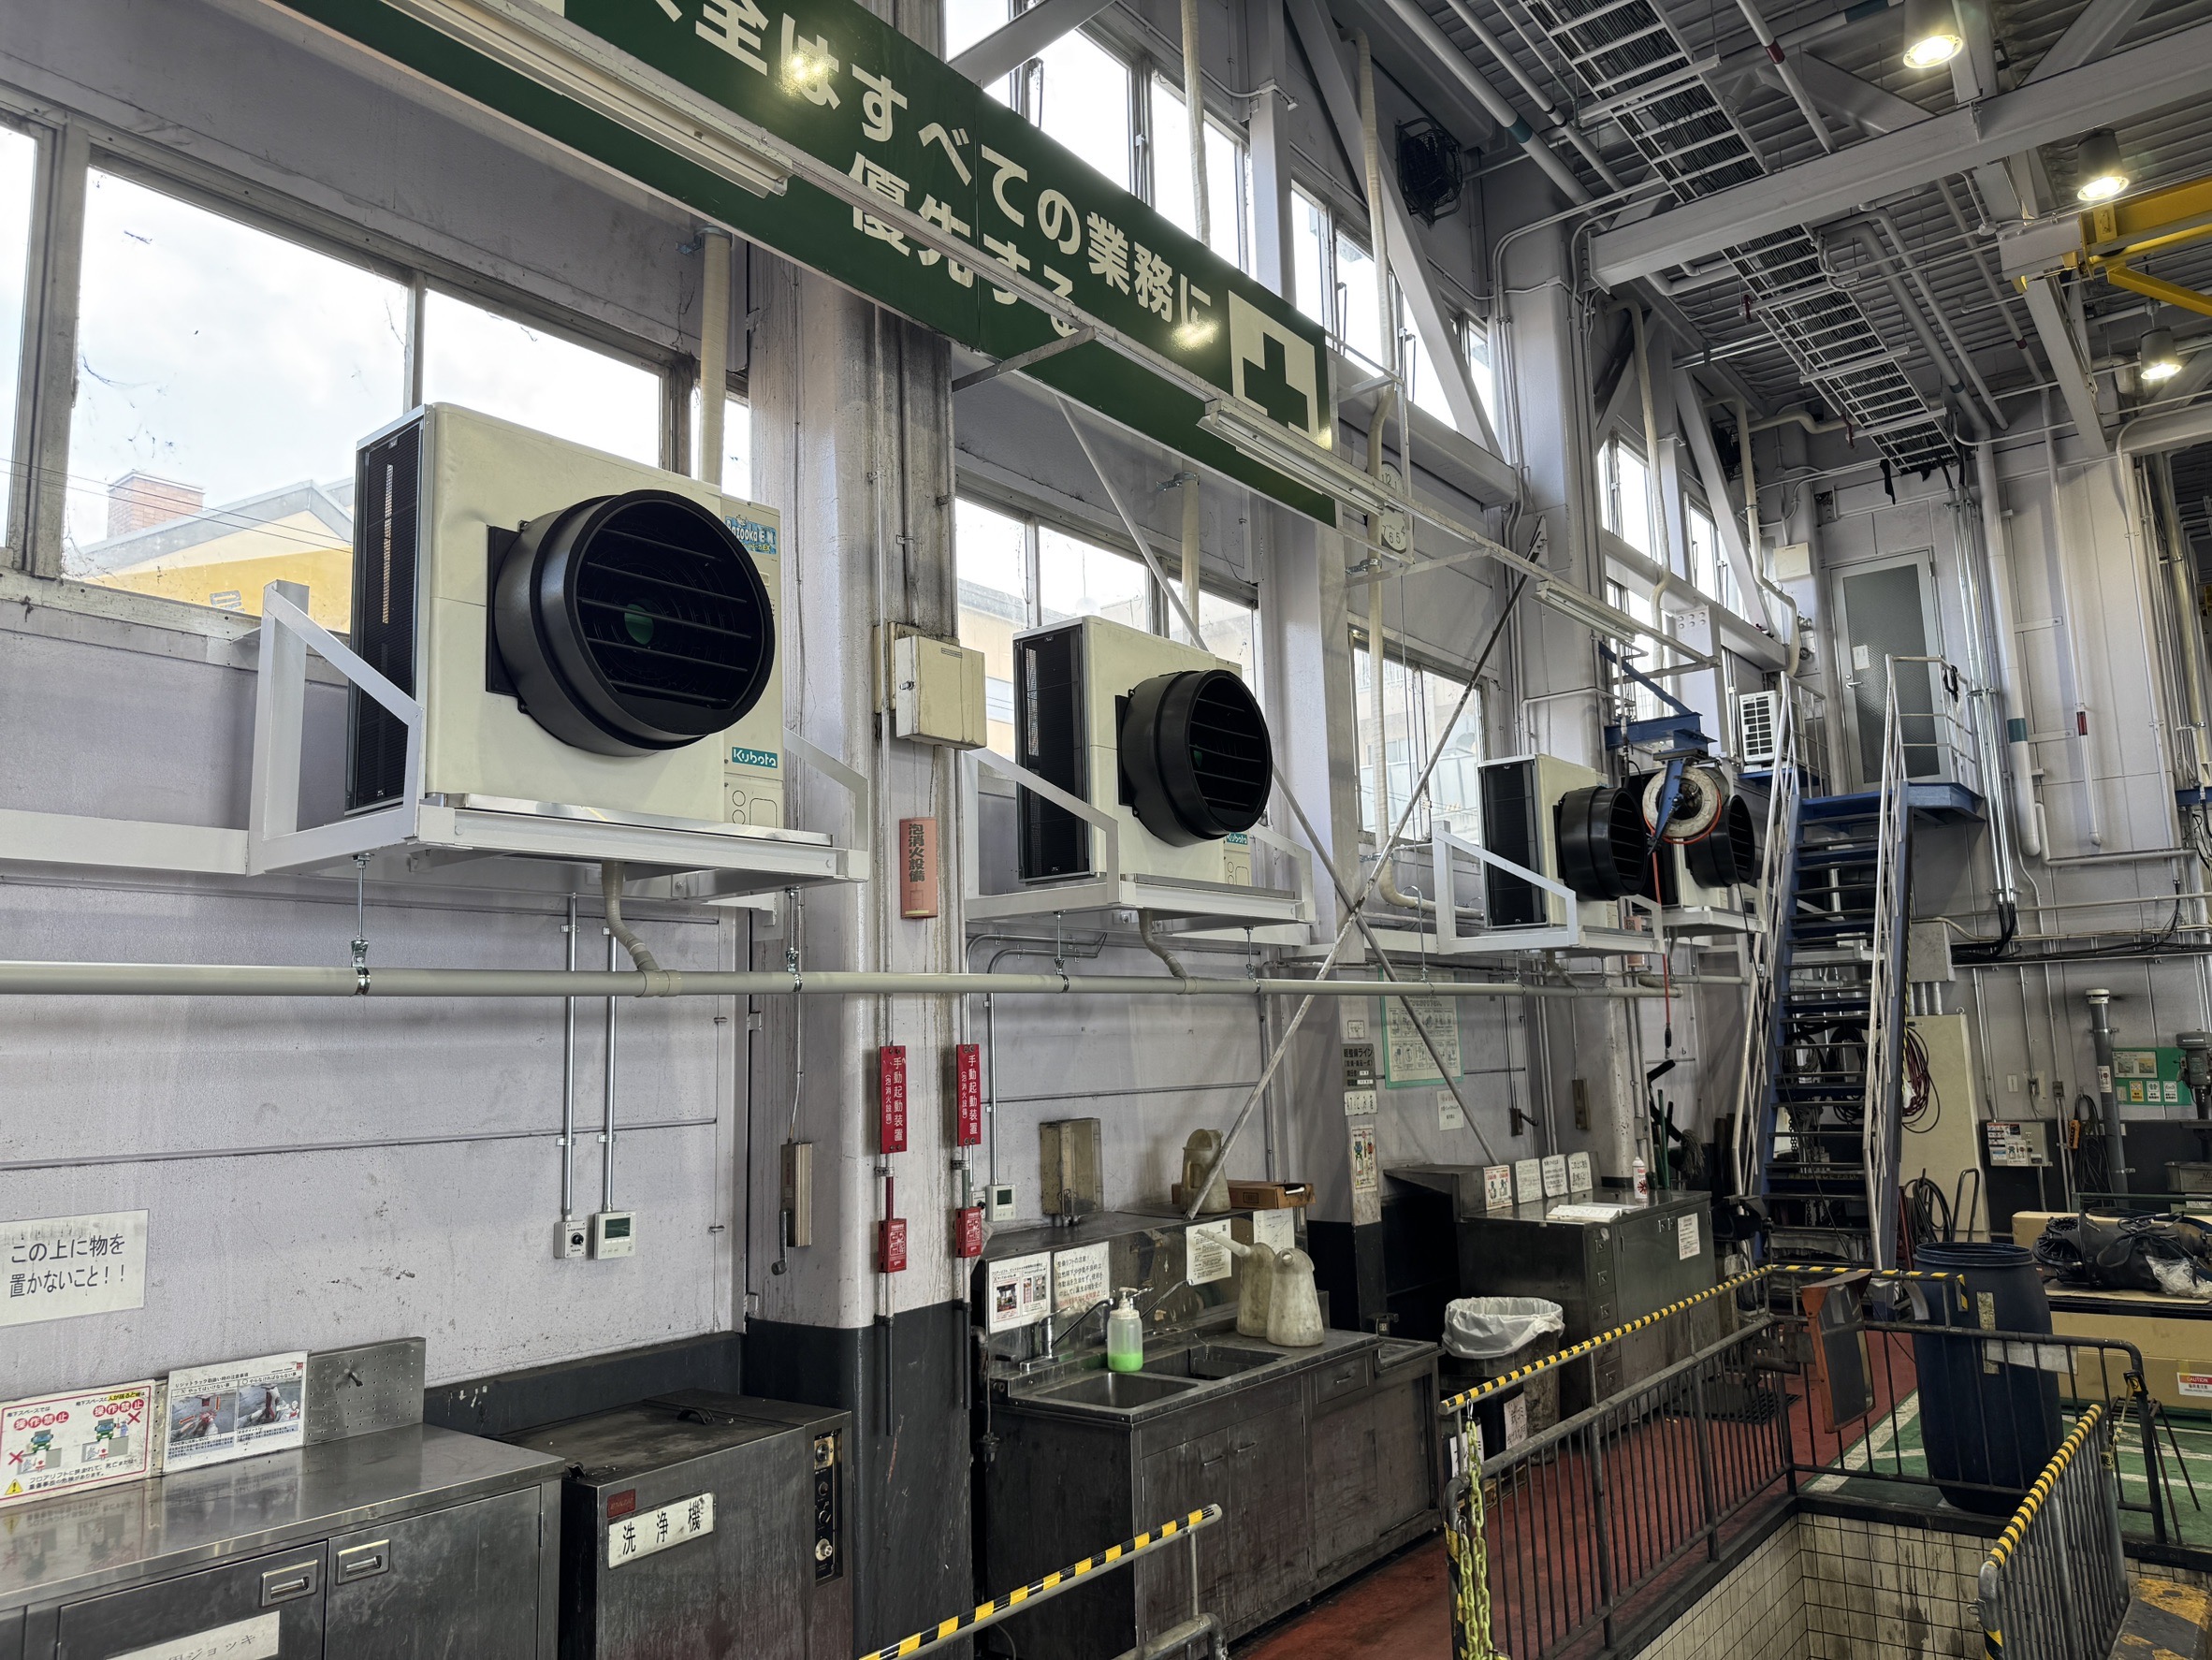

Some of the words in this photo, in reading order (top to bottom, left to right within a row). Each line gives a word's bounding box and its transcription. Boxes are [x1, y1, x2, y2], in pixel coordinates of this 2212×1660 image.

[657, 0, 1214, 343] 全はすべての業務に
[734, 748, 777, 767] Kubota
[909, 823, 924, 882] 泡消火設備
[893, 1056, 903, 1142] 手動起動装置
[968, 1055, 978, 1135] 手動起動装置
[11, 1233, 125, 1263] この上に物を
[10, 1264, 124, 1298] 置かないこと！！
[14, 1411, 69, 1431] 操作禁止
[94, 1399, 144, 1417] 操作禁止
[622, 1499, 701, 1555] 洗浄機
